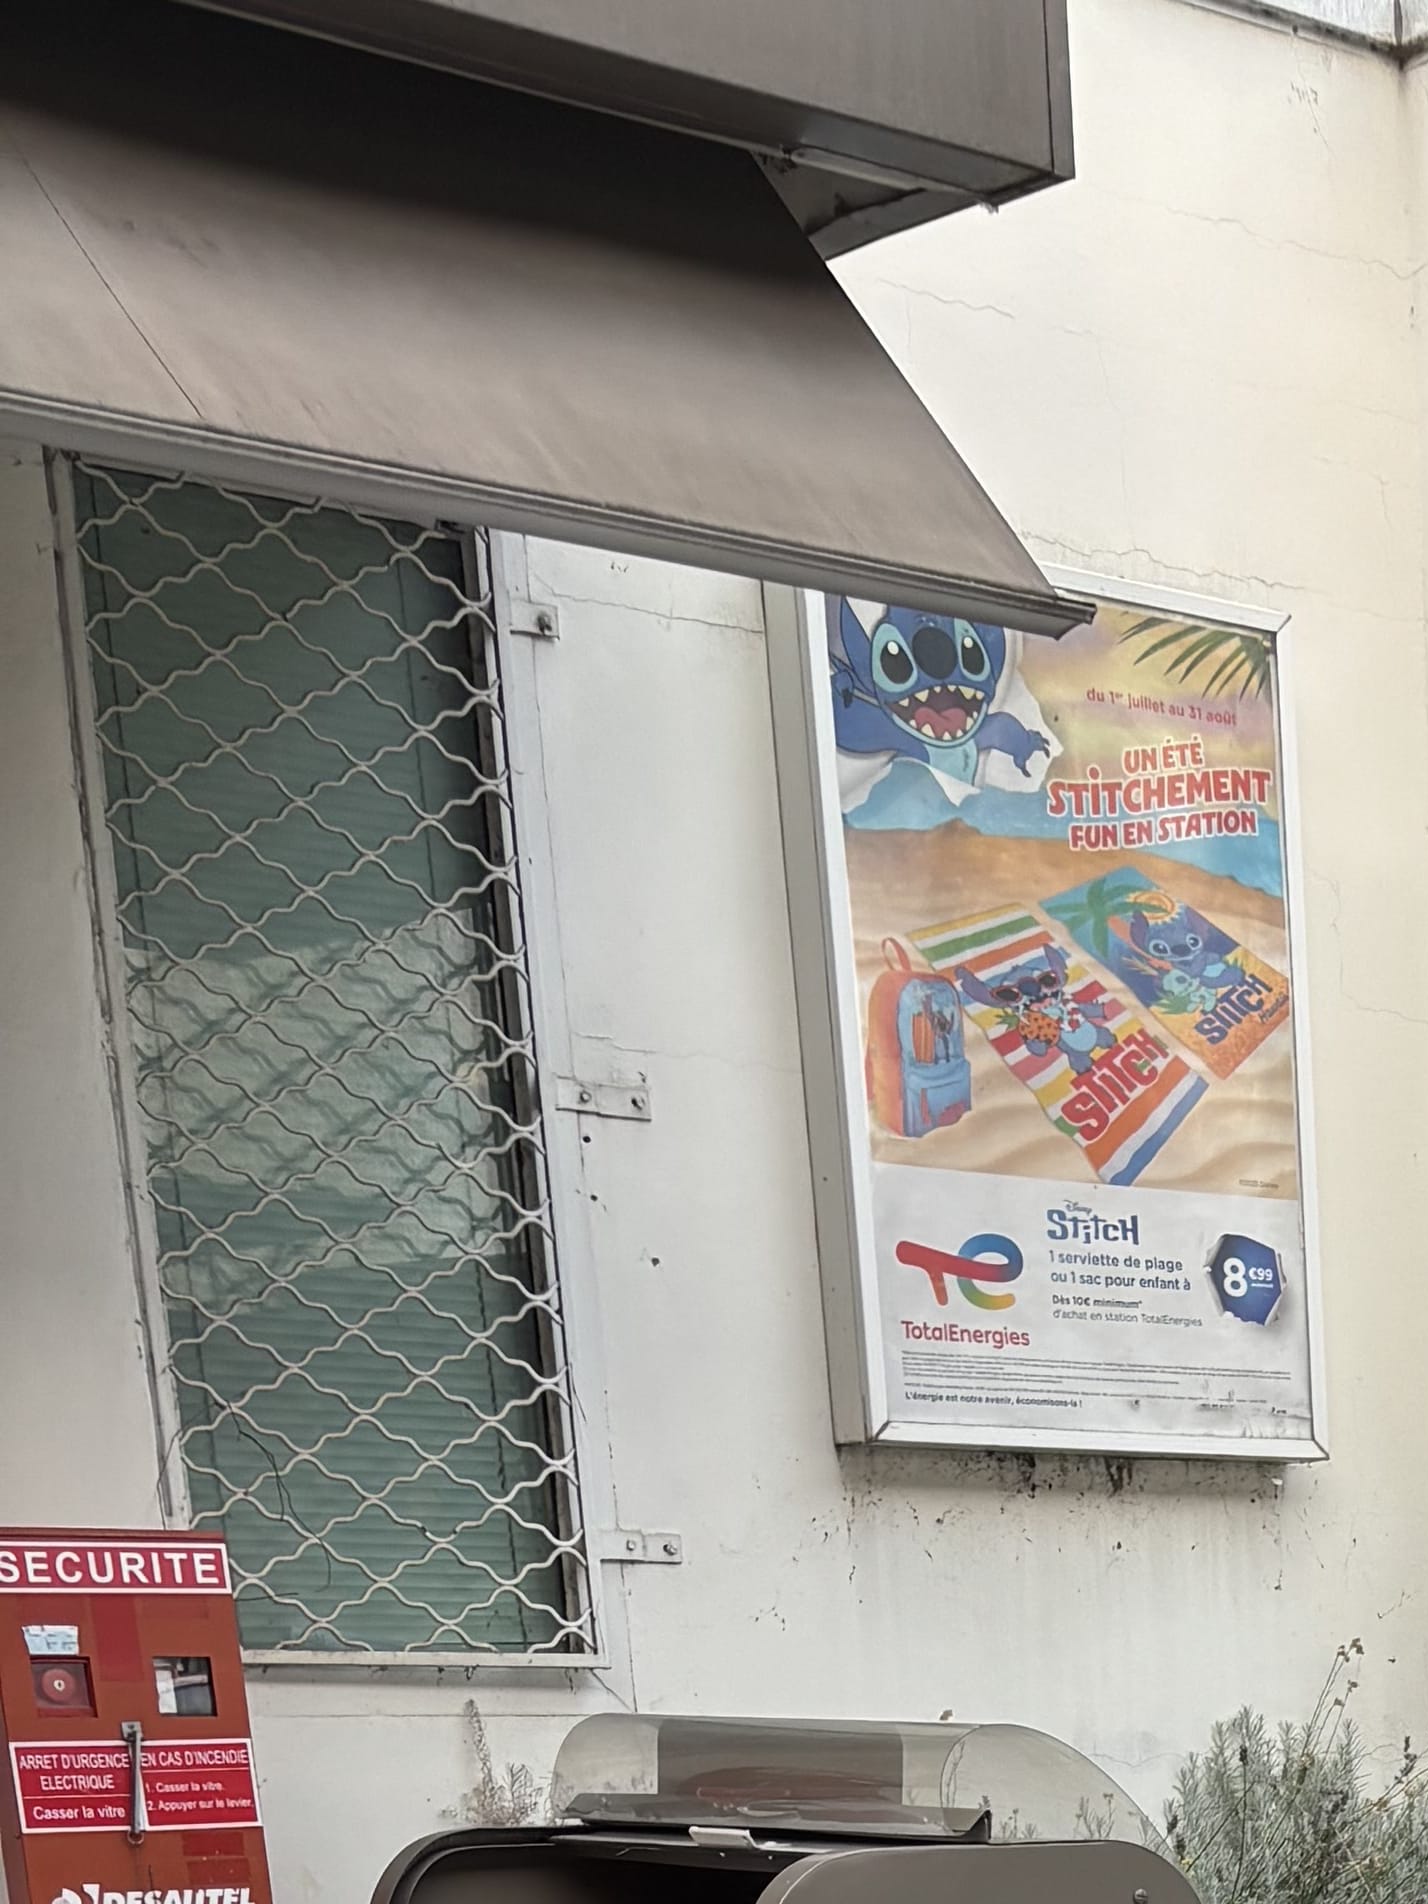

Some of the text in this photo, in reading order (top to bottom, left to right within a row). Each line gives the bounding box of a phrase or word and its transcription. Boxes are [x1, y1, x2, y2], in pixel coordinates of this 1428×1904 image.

[1086, 688, 1105, 703] du
[1128, 693, 1165, 713] juillet
[1168, 704, 1185, 717] au
[1189, 705, 1202, 720] 31
[1206, 711, 1237, 727] août
[1123, 736, 1203, 774] UN ÉTÉ
[1070, 810, 1257, 849] FUN EN STATION
[1049, 1250, 1183, 1273] 1 serviette de plage
[1051, 1271, 1191, 1291] ou 1 sac pour enfant à
[1105, 1311, 1138, 1323] station
[1141, 1313, 1203, 1328] TotalEnergies
[900, 1320, 1031, 1350] TotalEnergies
[0, 1550, 219, 1584] SECURITE
[19, 1753, 130, 1769] ARRET D'URGENCE
[141, 1749, 249, 1767] EN CAS D'INCENDIE
[40, 1774, 115, 1791] ELECTRIQUE
[156, 1782, 190, 1793] Casser
[33, 1804, 125, 1820] Casser la vitre
[158, 1799, 197, 1812] Appuyer
